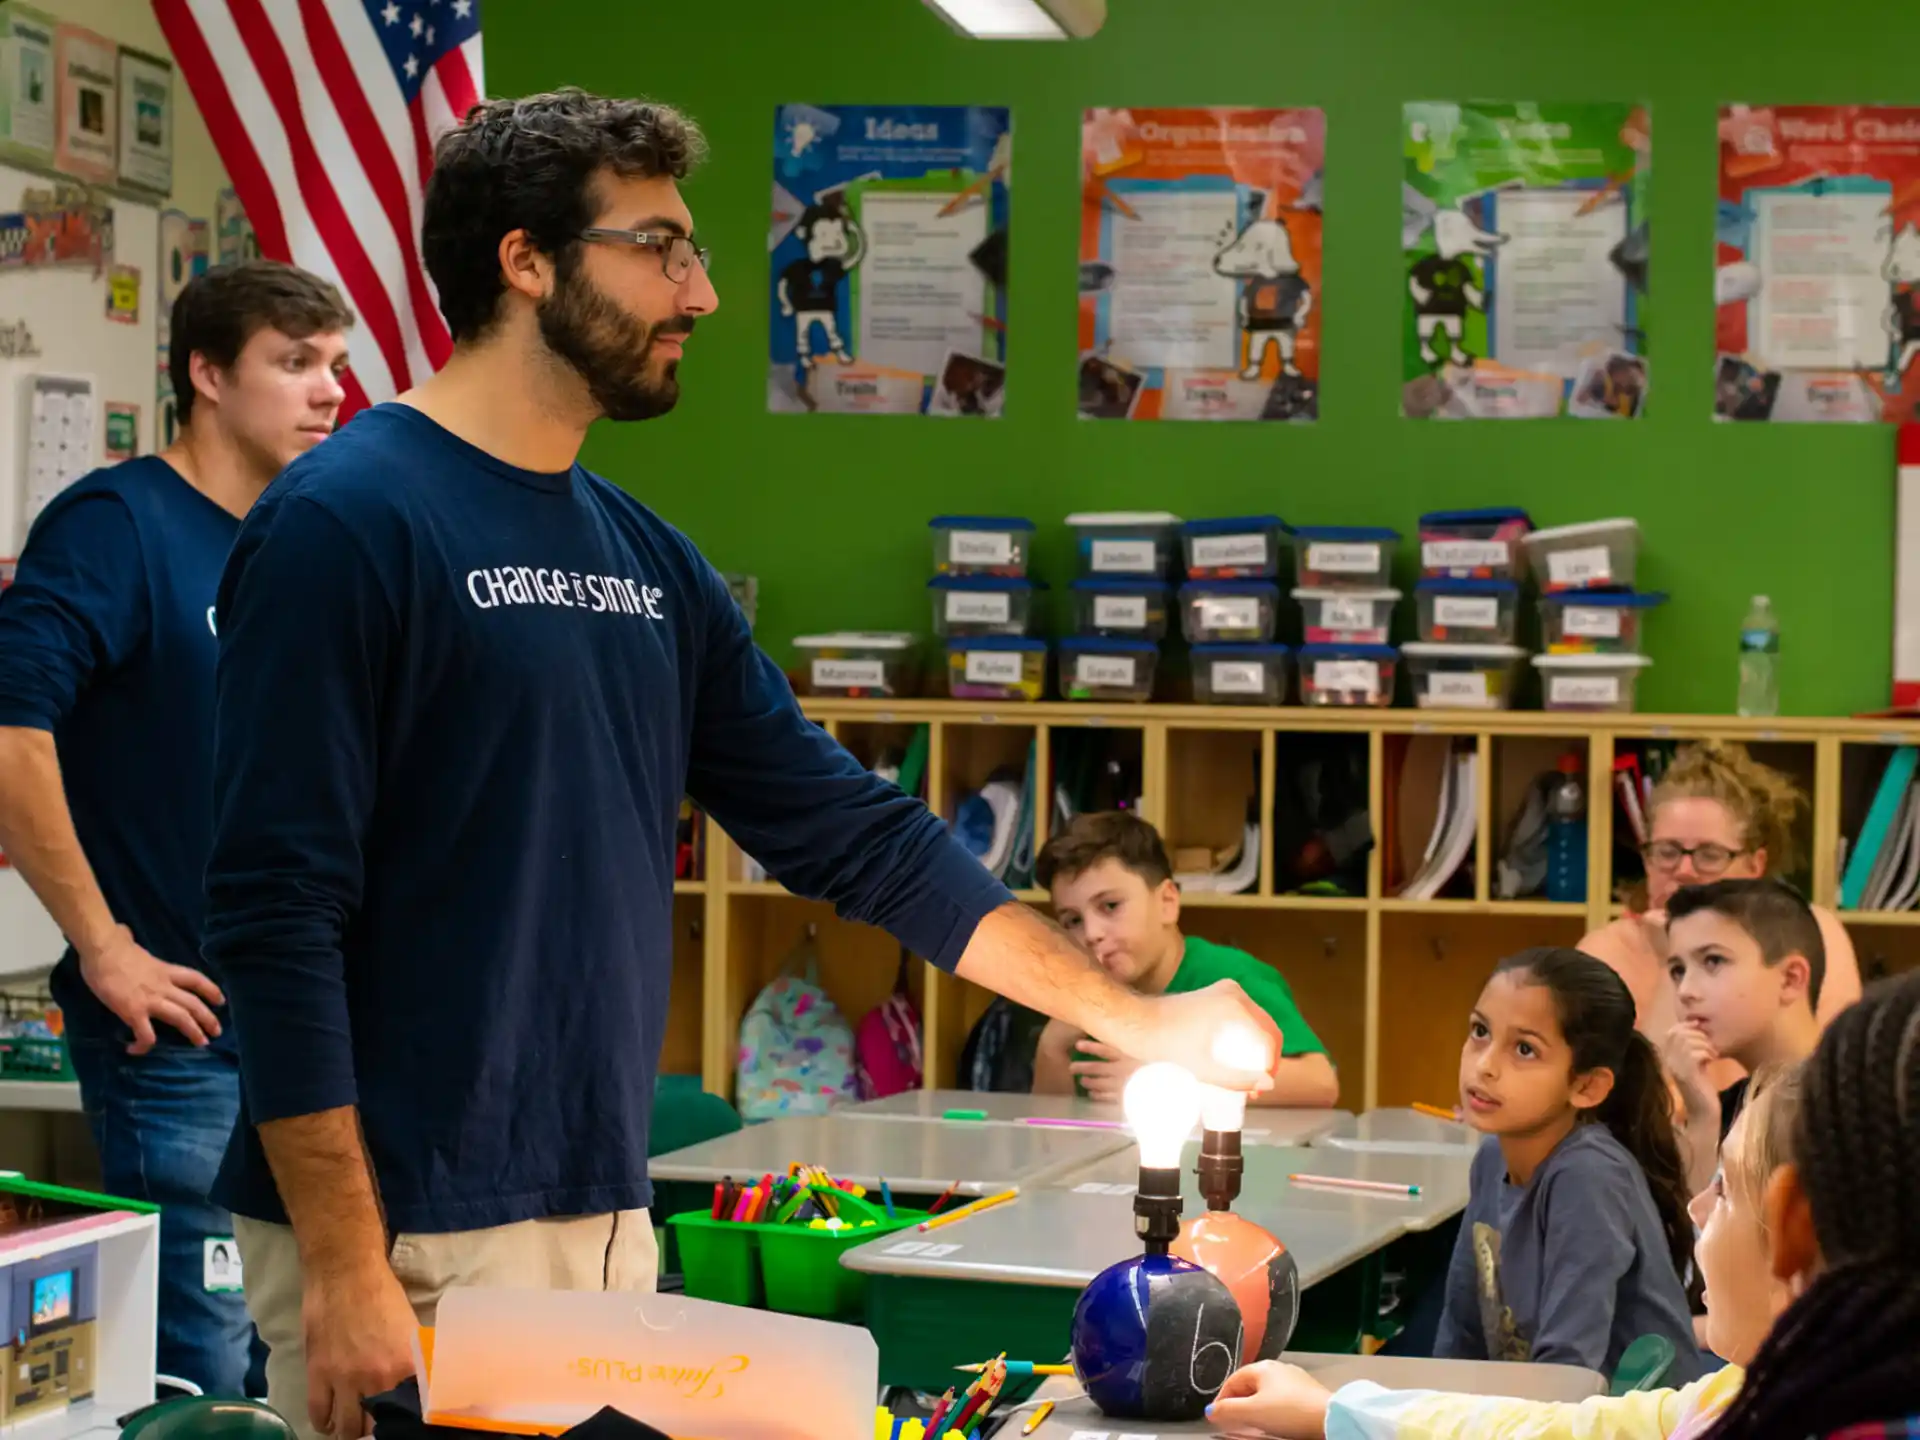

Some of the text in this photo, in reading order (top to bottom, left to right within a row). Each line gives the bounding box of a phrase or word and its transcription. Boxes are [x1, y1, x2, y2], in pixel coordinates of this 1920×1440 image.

[864, 117, 939, 141] Ideas
[1780, 119, 1845, 142] Word
[576, 1354, 750, 1398] Juice PLUS
